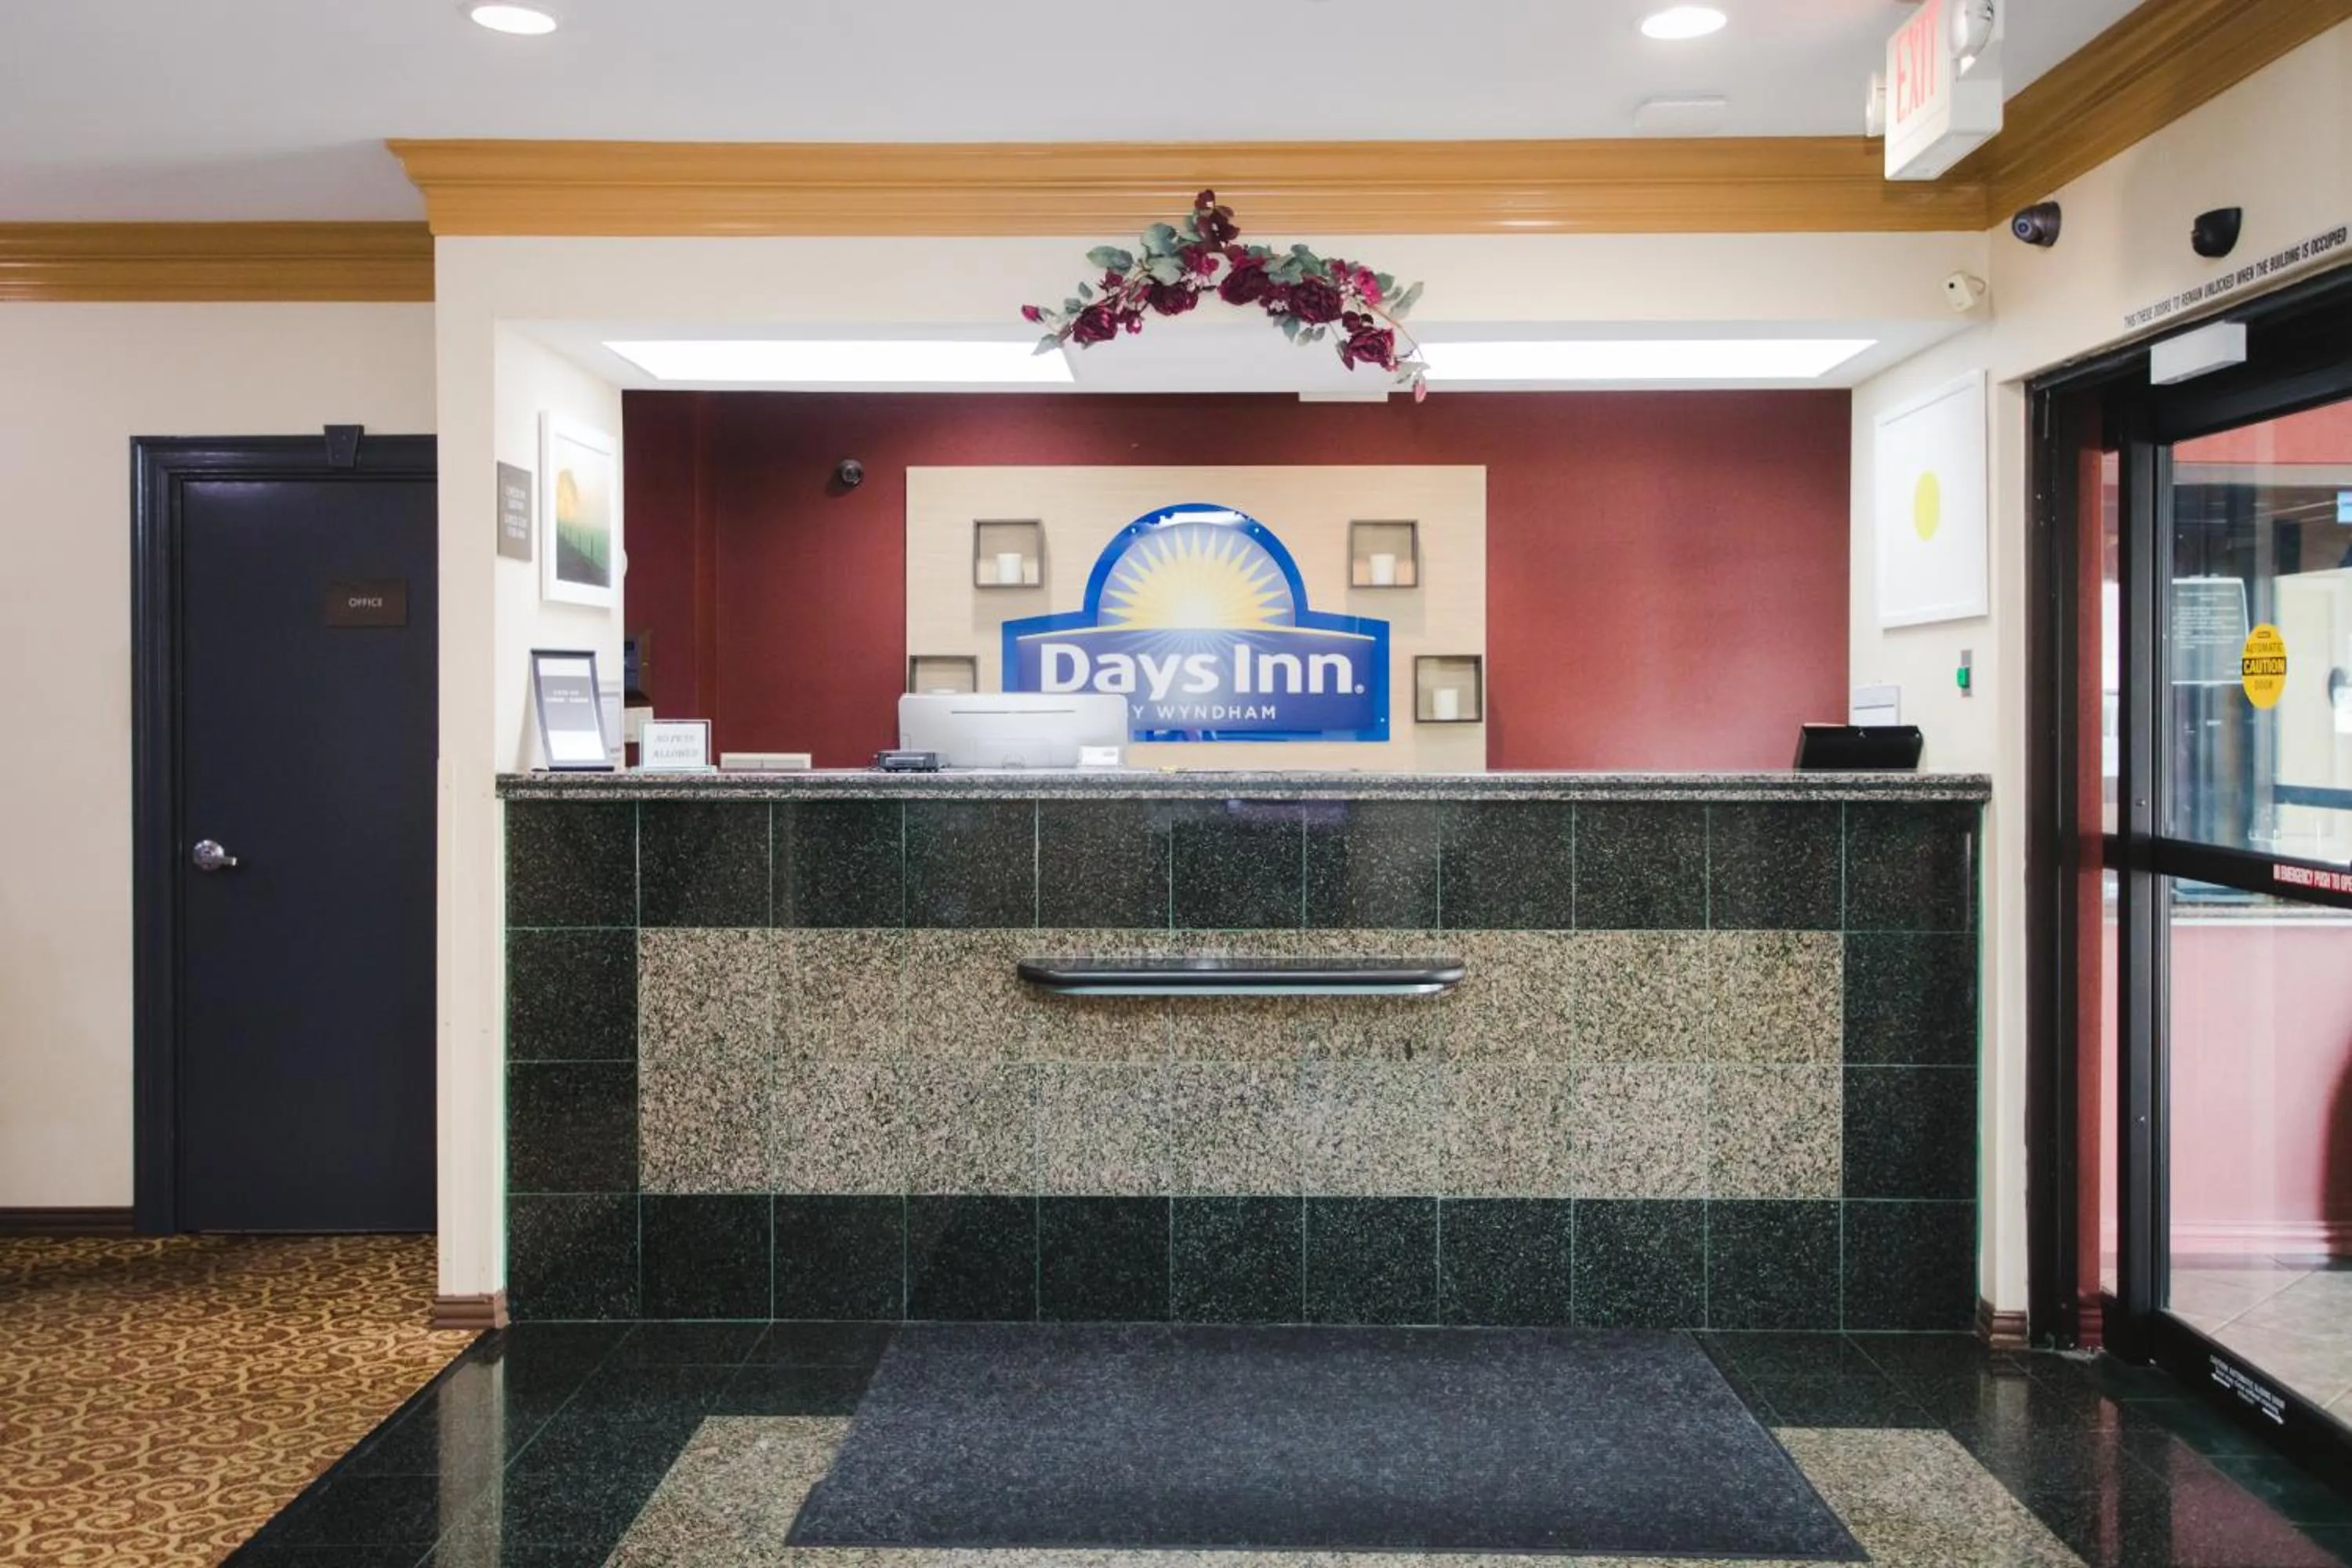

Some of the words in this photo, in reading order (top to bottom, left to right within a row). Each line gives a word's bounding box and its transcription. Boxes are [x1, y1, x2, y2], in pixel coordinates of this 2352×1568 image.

[1896, 0, 1941, 123] EXIT
[2204, 273, 2234, 298] UNLOCKED
[2236, 265, 2254, 285] WHEN
[2256, 259, 2268, 278] THE
[2270, 246, 2300, 271] BUILDING
[2302, 241, 2309, 259] IS
[2310, 227, 2347, 256] OCCUPIED
[348, 597, 383, 608] OFFICE
[2245, 642, 2283, 653] AUTOMATIC
[1040, 643, 1219, 702] Days
[1233, 643, 1353, 694] Inn
[2243, 659, 2285, 673] CAUTION
[1156, 705, 1276, 720] WYNDHAM
[2281, 865, 2314, 888] EMERGENCY
[2314, 869, 2331, 890] PUSH
